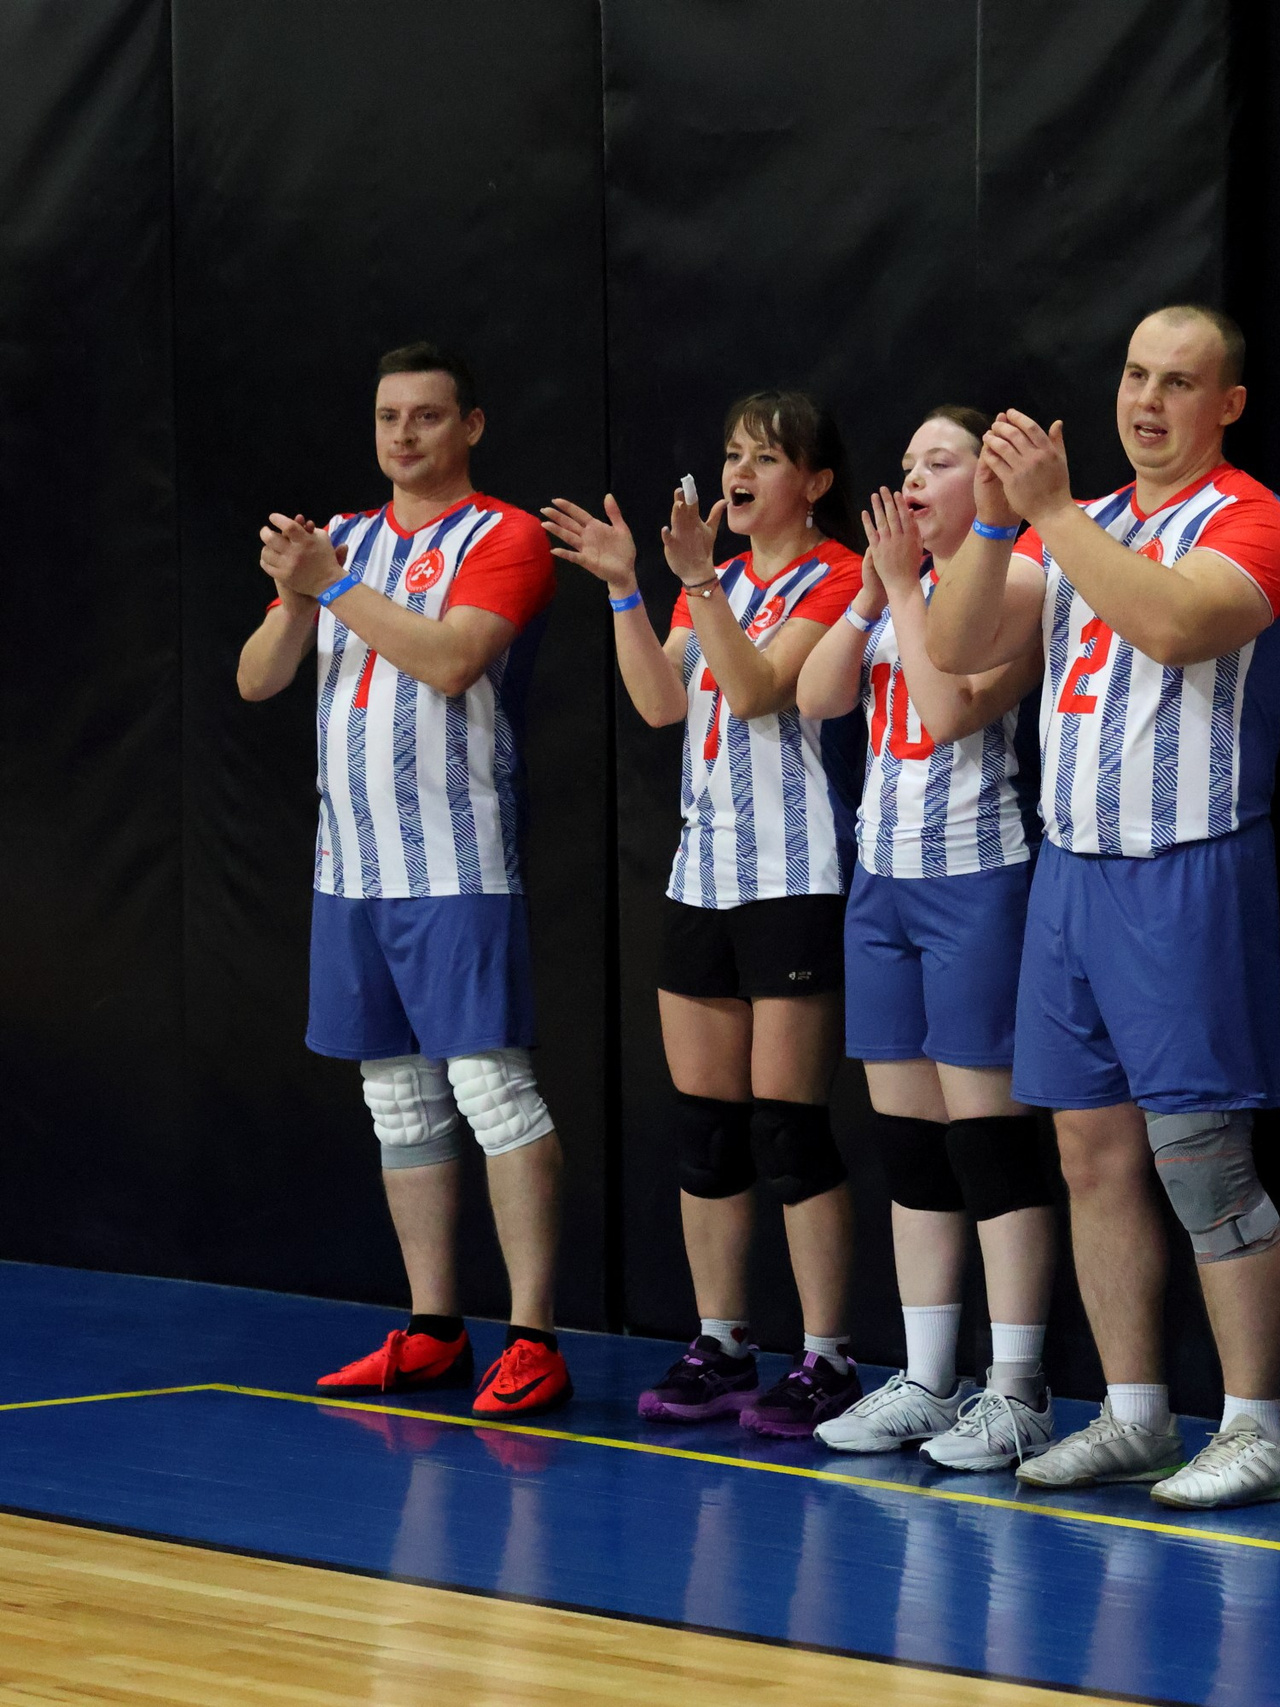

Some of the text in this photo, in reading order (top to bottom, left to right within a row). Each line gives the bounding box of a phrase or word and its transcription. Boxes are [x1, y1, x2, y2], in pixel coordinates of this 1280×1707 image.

[753, 607, 773, 628] 2
[1057, 617, 1114, 714] 2
[870, 662, 936, 761] 10
